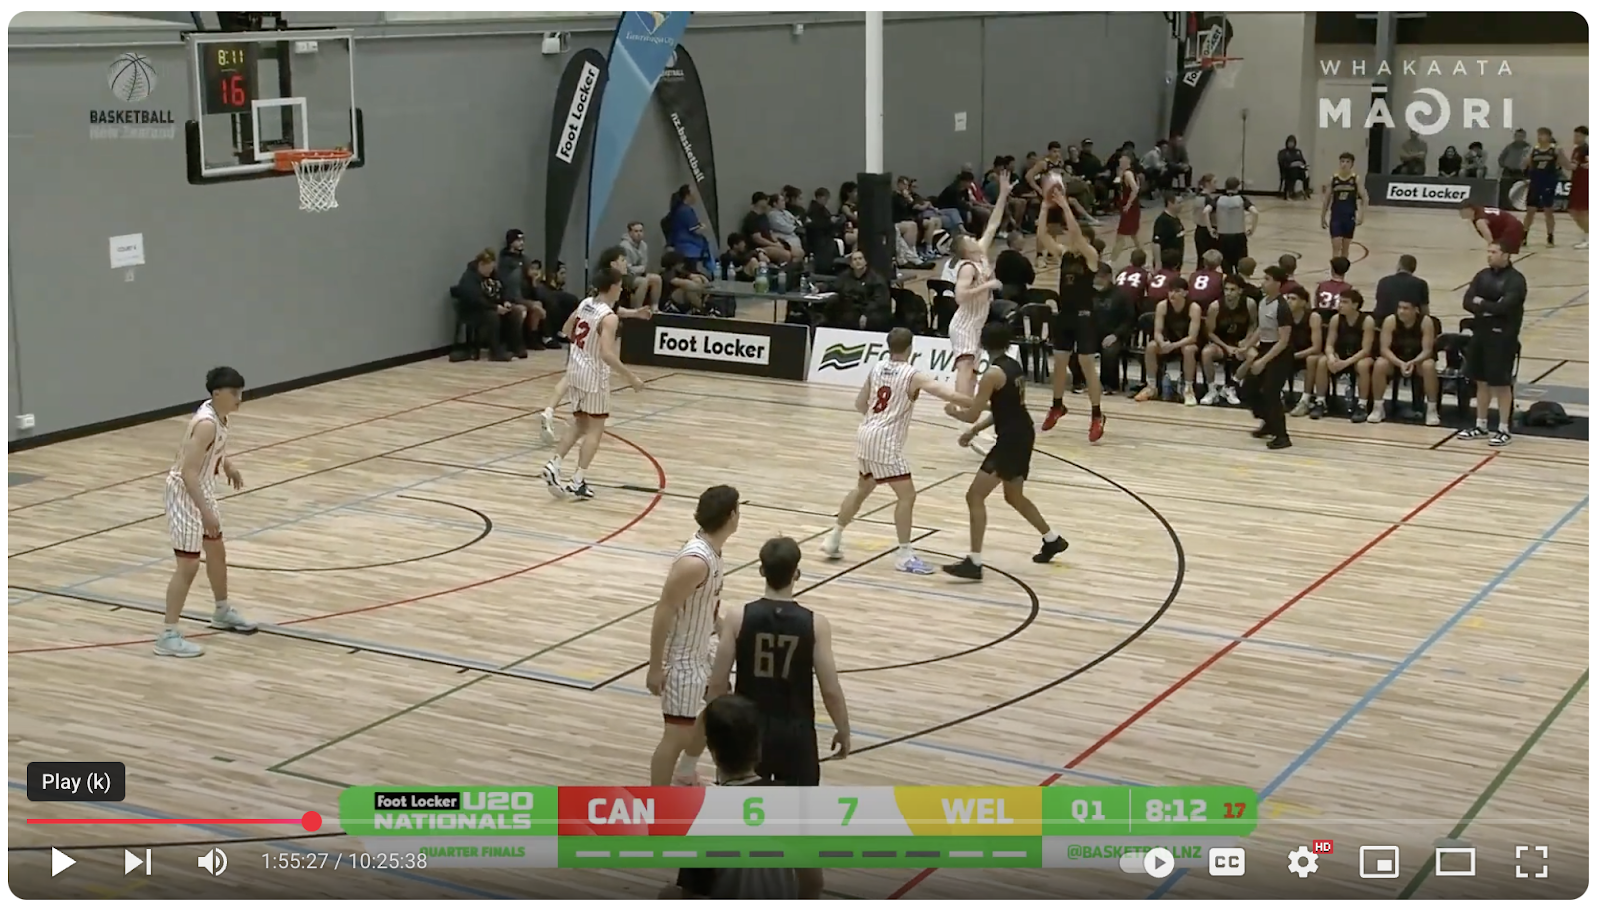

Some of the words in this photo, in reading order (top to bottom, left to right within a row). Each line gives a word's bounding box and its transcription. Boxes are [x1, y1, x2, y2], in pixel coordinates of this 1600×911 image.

[218, 49, 244, 66] 8:11
[222, 75, 245, 106] 16
[560, 123, 579, 158] Foot
[571, 68, 596, 121] Locker
[670, 112, 705, 183] nz.basketball
[1390, 185, 1418, 198] Foot
[1422, 187, 1467, 200] Locker
[1116, 271, 1141, 288] 44
[1151, 274, 1167, 289] 3
[1194, 275, 1209, 290] 8
[659, 332, 697, 353] Foot
[703, 335, 765, 359] Locker
[754, 632, 799, 679] 67
